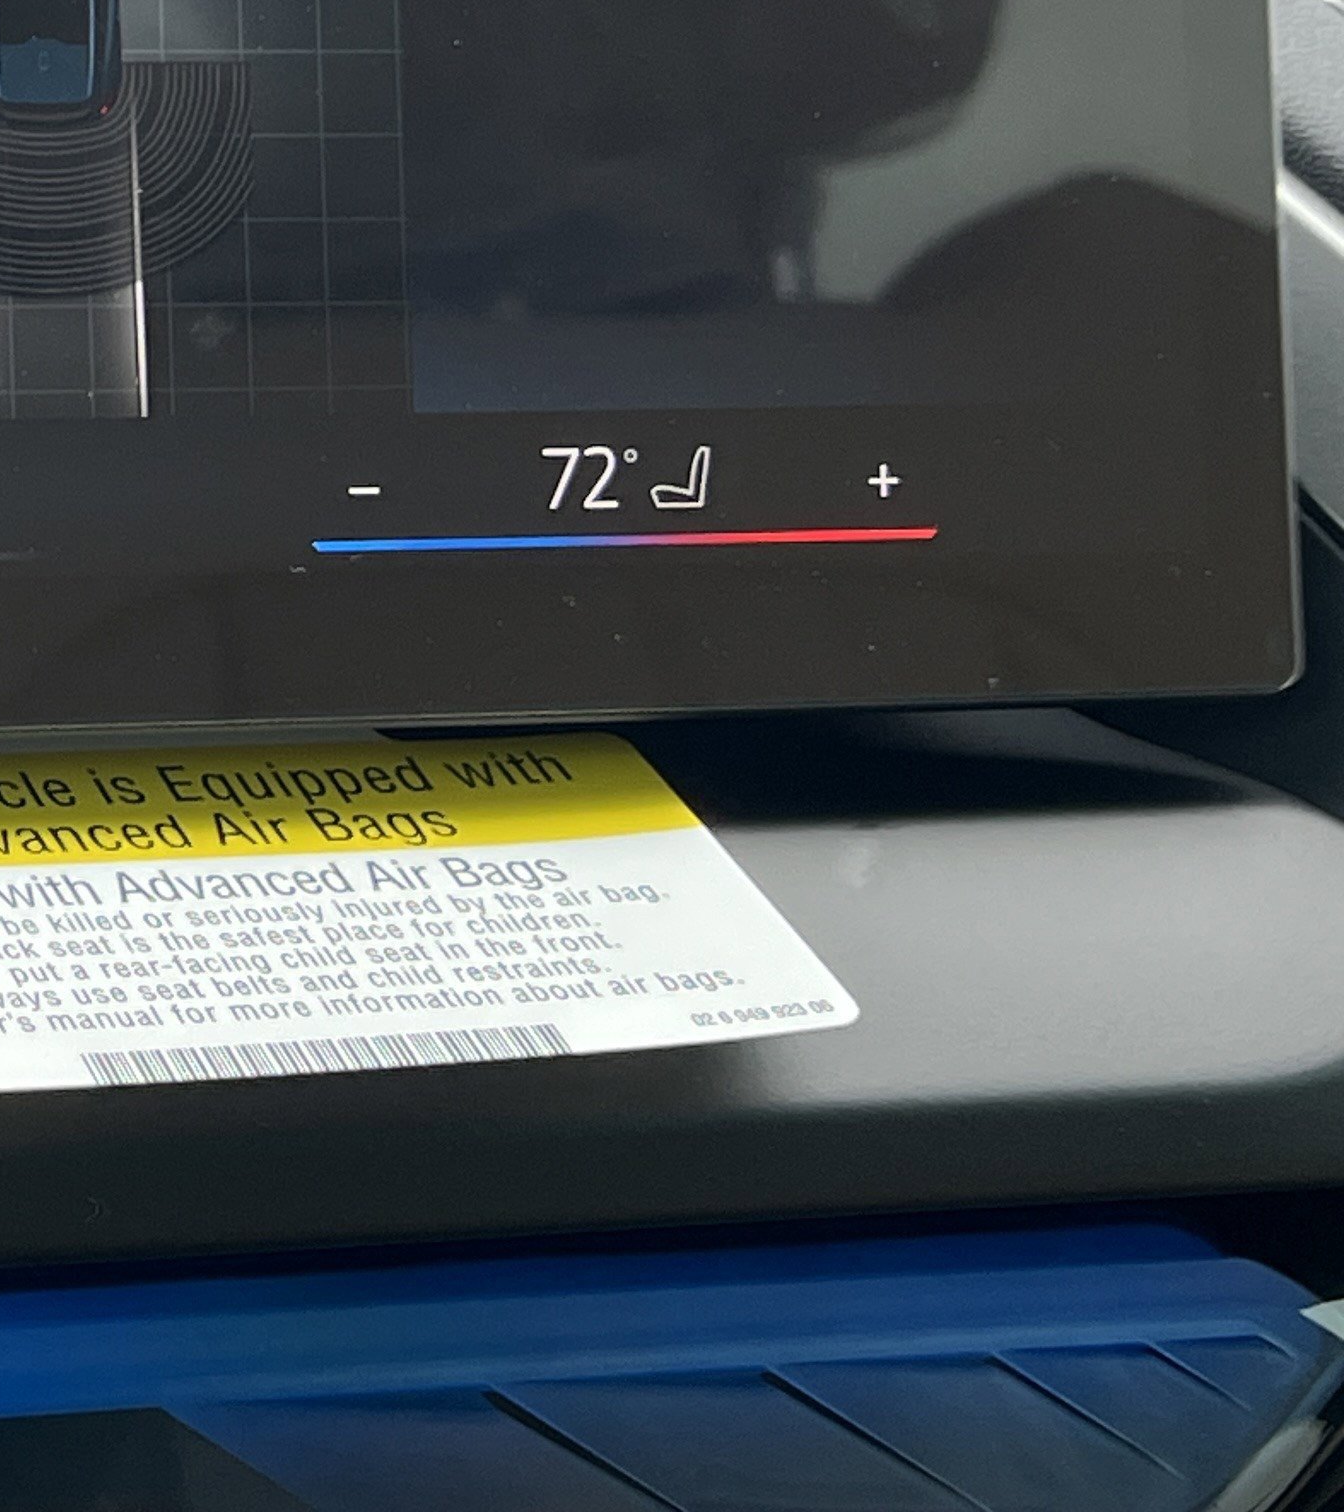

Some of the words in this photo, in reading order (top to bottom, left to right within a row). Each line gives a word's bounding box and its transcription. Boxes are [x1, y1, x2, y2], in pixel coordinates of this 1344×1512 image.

[86, 767, 146, 804] is
[156, 755, 434, 807] Equipped
[443, 749, 572, 789] with
[212, 810, 288, 846] Air
[305, 807, 457, 846] Bags
[114, 862, 355, 903] Advanced
[365, 859, 432, 892] Air
[439, 856, 568, 890] Bags
[46, 910, 133, 933] killed
[143, 911, 173, 929] or
[185, 901, 324, 927] seriously
[332, 894, 443, 921] injured
[447, 892, 489, 915] by
[494, 889, 545, 909] the
[553, 886, 592, 906] air
[598, 884, 670, 904] bag.
[8, 962, 63, 987] put
[71, 964, 90, 980] a
[98, 953, 272, 979] rear-facing
[280, 945, 357, 968] child
[365, 942, 431, 963] seat
[435, 940, 470, 960] in
[474, 937, 527, 957] the
[531, 930, 623, 954] front.
[47, 936, 116, 957] seat
[121, 934, 152, 954] is
[158, 930, 210, 952] the
[218, 925, 315, 948] safest
[322, 921, 405, 945] place
[410, 918, 456, 938] for
[466, 912, 602, 934] children.
[47, 1005, 163, 1032] manual
[170, 1004, 217, 1025] for
[228, 999, 312, 1022] more
[317, 987, 504, 1016] information
[512, 979, 603, 1004] about
[608, 974, 649, 996] air
[654, 970, 745, 992] bags.
[71, 986, 128, 1006] use
[137, 978, 206, 1001] seat
[210, 975, 291, 998] belts
[299, 969, 358, 992] and
[367, 964, 443, 988] child
[452, 956, 612, 983] restraints.
